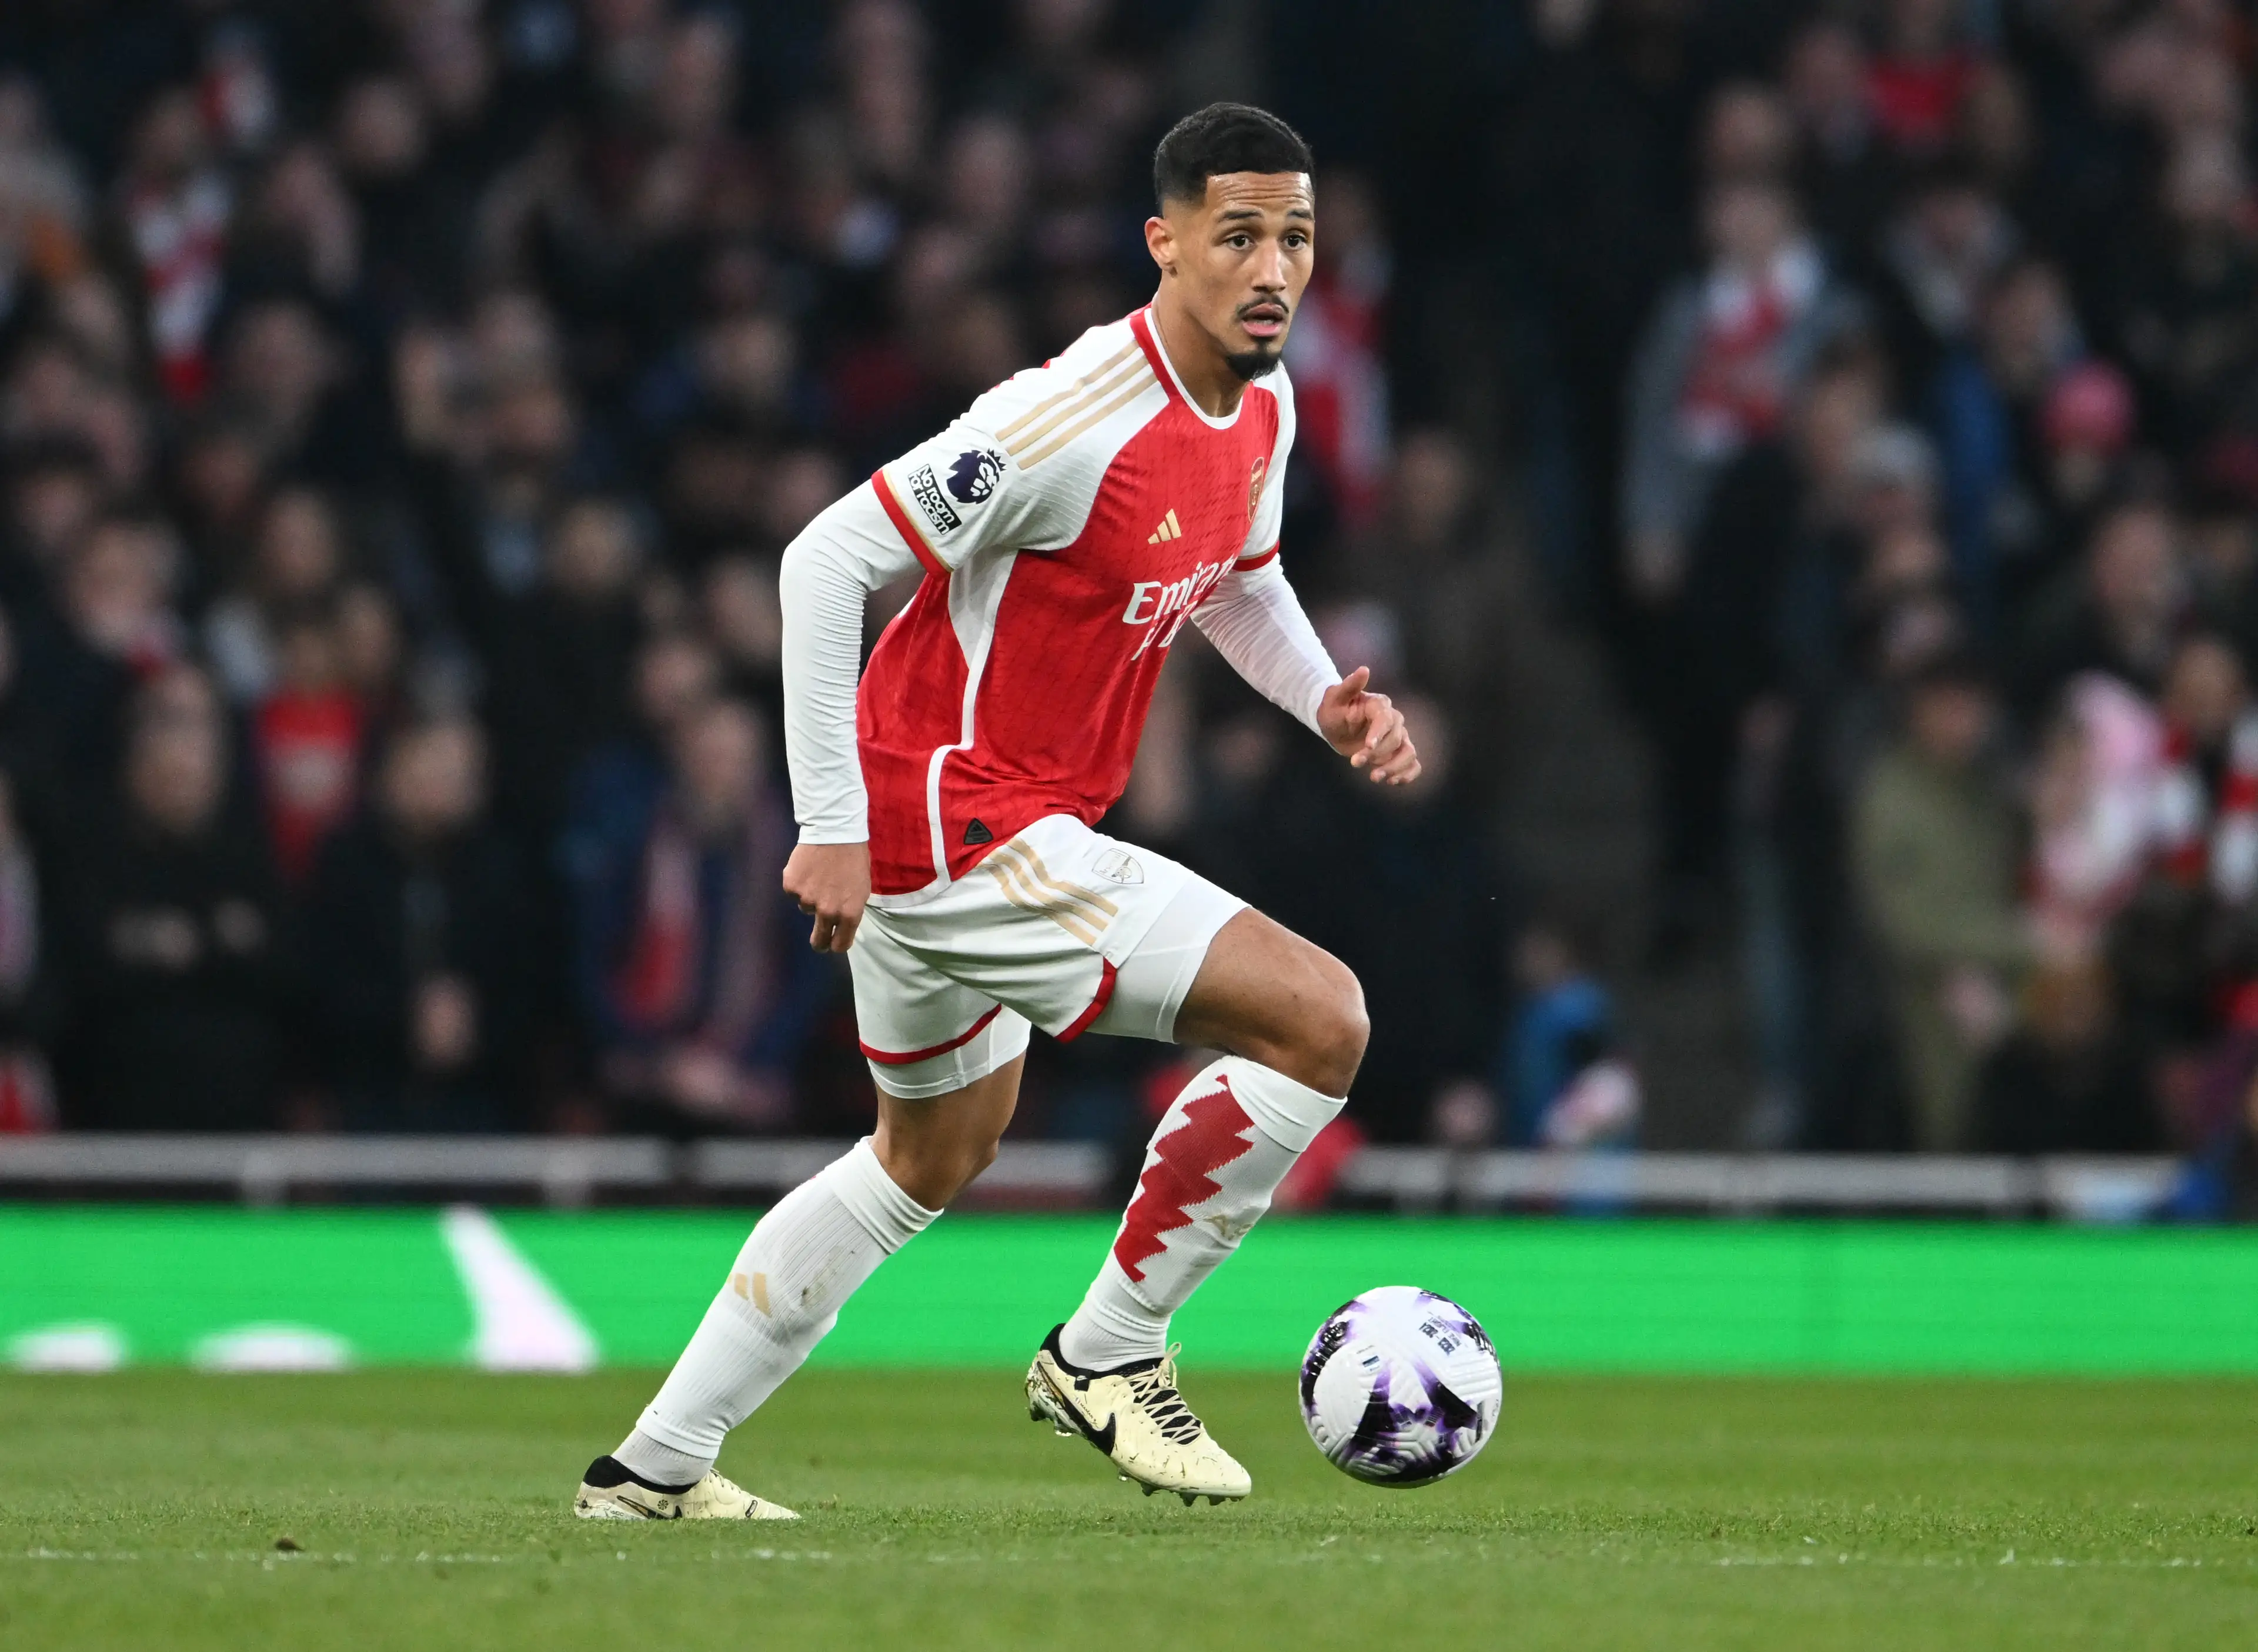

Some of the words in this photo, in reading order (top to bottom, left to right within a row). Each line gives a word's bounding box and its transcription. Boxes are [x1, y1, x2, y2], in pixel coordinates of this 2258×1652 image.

[909, 471, 924, 491] for
[921, 464, 933, 488] No
[927, 487, 955, 523] room
[916, 491, 950, 535] racism
[1122, 553, 1238, 624] Emirat
